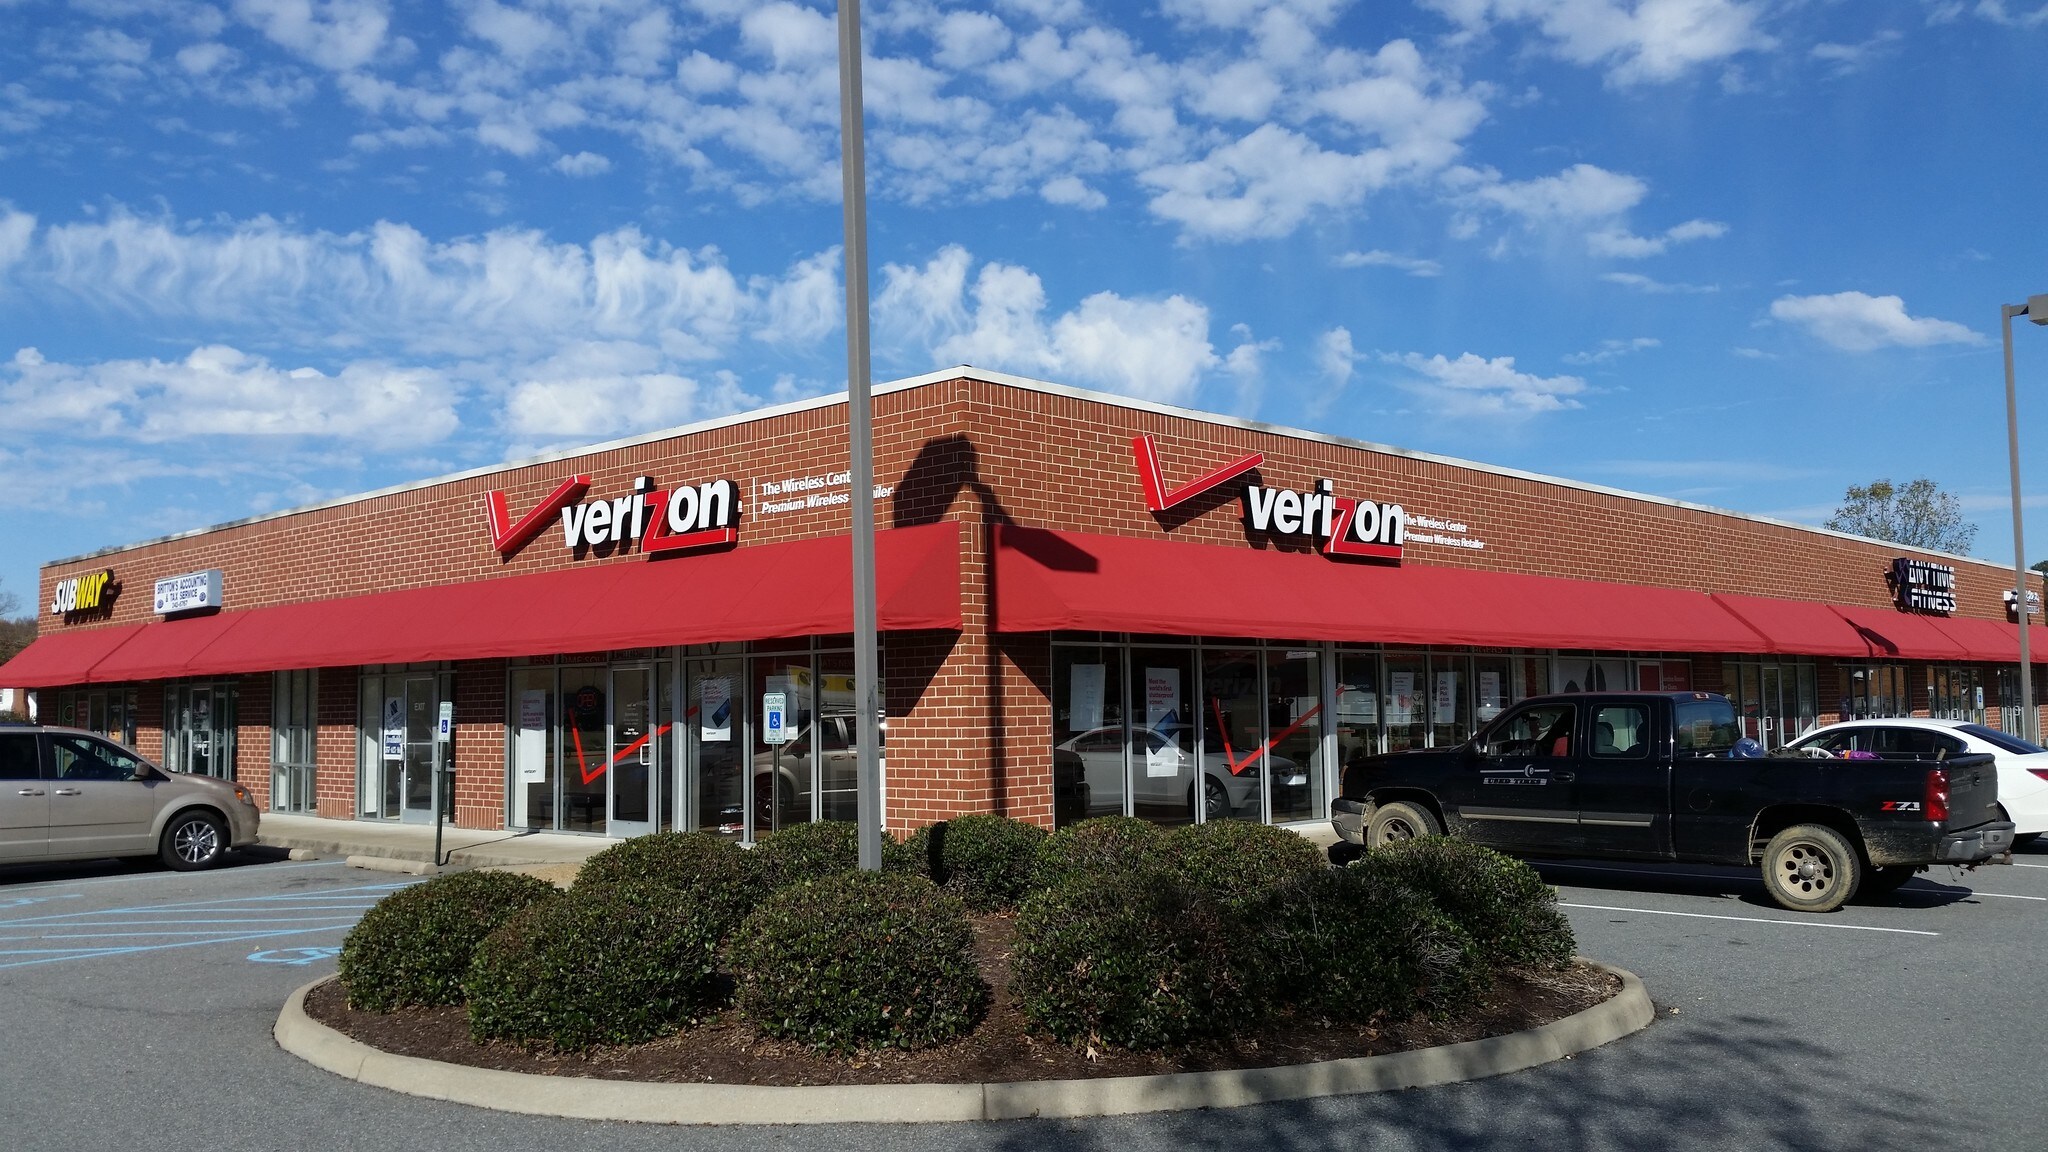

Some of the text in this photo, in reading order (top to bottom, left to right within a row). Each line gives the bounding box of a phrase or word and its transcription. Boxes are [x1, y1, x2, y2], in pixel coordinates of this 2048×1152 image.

[762, 470, 851, 496] The Wireless Cent
[762, 500, 804, 514] Premium
[806, 492, 849, 508] Wireless
[561, 476, 730, 553] verizon
[1248, 478, 1403, 559] verizon
[1404, 513, 1467, 532] The Wireless Center
[1404, 530, 1484, 549] Premium Wireless Retailer
[180, 575, 206, 589] ACCOUNTING
[1908, 559, 1955, 589] ANYTIME
[51, 571, 108, 613] SUBWAY
[170, 592, 178, 601] TAX
[179, 588, 198, 600] SERVICE
[1911, 588, 1956, 612] FITNESS
[414, 703, 425, 711] EXIT
[1881, 802, 1920, 811] Z71
